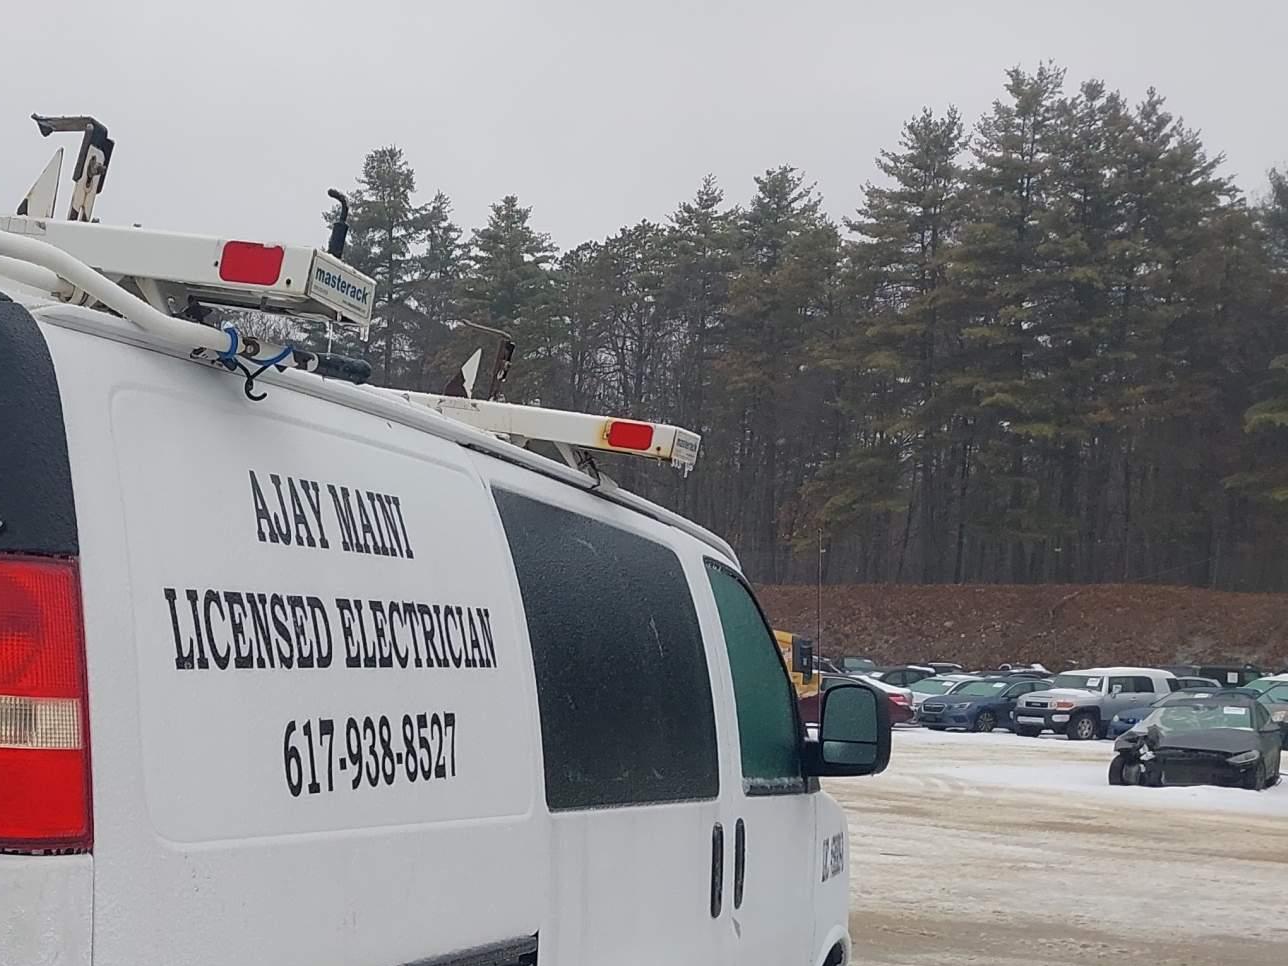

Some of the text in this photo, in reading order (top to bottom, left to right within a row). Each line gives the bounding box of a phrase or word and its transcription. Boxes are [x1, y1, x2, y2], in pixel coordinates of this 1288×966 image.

[315, 267, 368, 305] masterack
[248, 470, 414, 560] AJAY MAINI
[163, 587, 497, 671] LICENSED ELECTRICIAN
[283, 711, 456, 798] 617-938-8527
